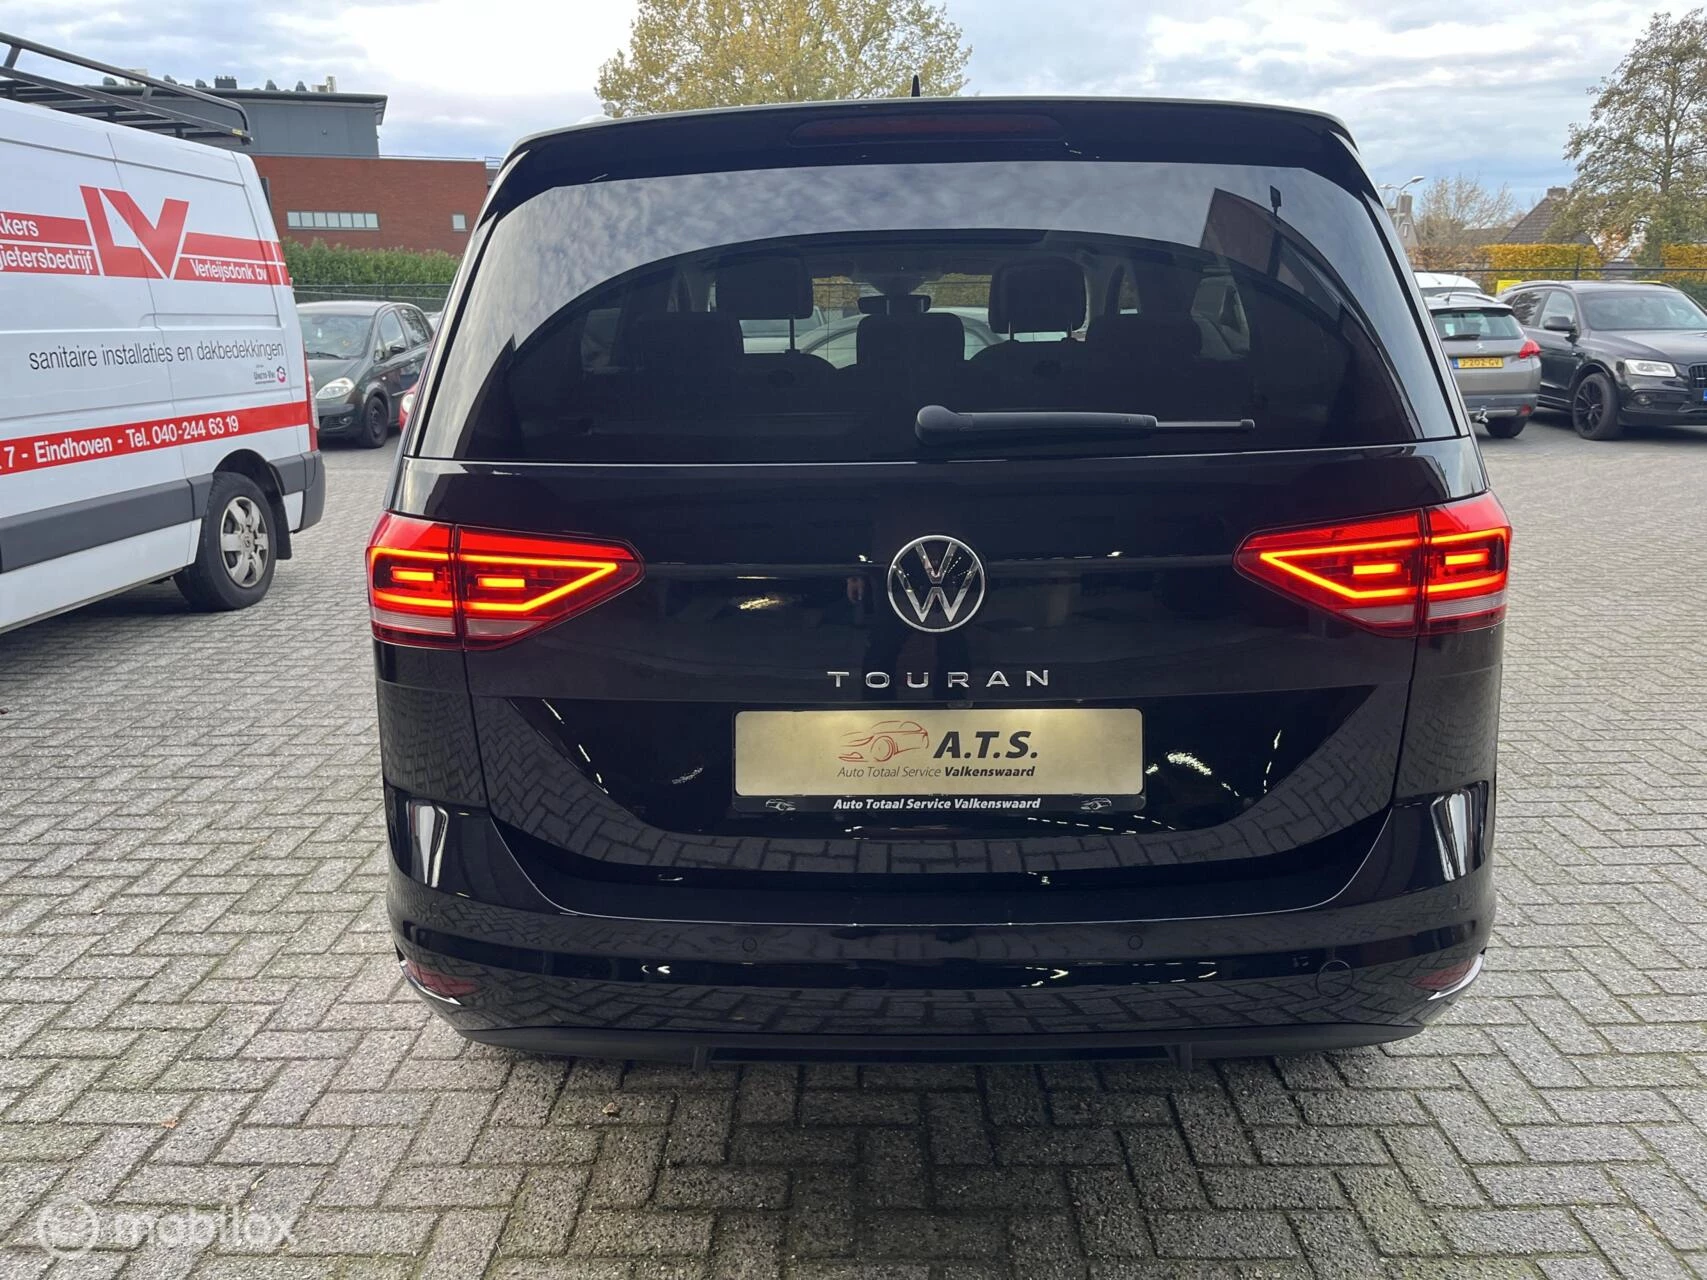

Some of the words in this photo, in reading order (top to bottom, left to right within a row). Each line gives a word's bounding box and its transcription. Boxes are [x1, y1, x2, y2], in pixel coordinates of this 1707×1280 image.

[80, 185, 190, 279] LV
[190, 259, 254, 281] Verleijsdonk
[255, 265, 267, 280] bv
[29, 345, 98, 370] sanitaire
[101, 342, 173, 366] installaties
[177, 346, 194, 362] en
[196, 339, 283, 361] dakbedekkingen
[3, 446, 15, 468] 7
[33, 436, 112, 463] Eindhoven
[126, 428, 150, 448] Tel.
[152, 419, 206, 444] 040-244
[208, 417, 224, 436] 63
[226, 415, 239, 433] 19
[827, 669, 1049, 688] TOURAN
[933, 731, 1038, 759] A.T.S.
[837, 766, 864, 778] Auto
[867, 766, 899, 777] Totaal
[902, 766, 941, 777] Service
[944, 766, 1035, 777] Valkenswaard
[833, 799, 863, 810] Auto
[866, 799, 903, 809] Totaal
[905, 798, 951, 809] Service
[954, 798, 1041, 809] Valkenswaard
